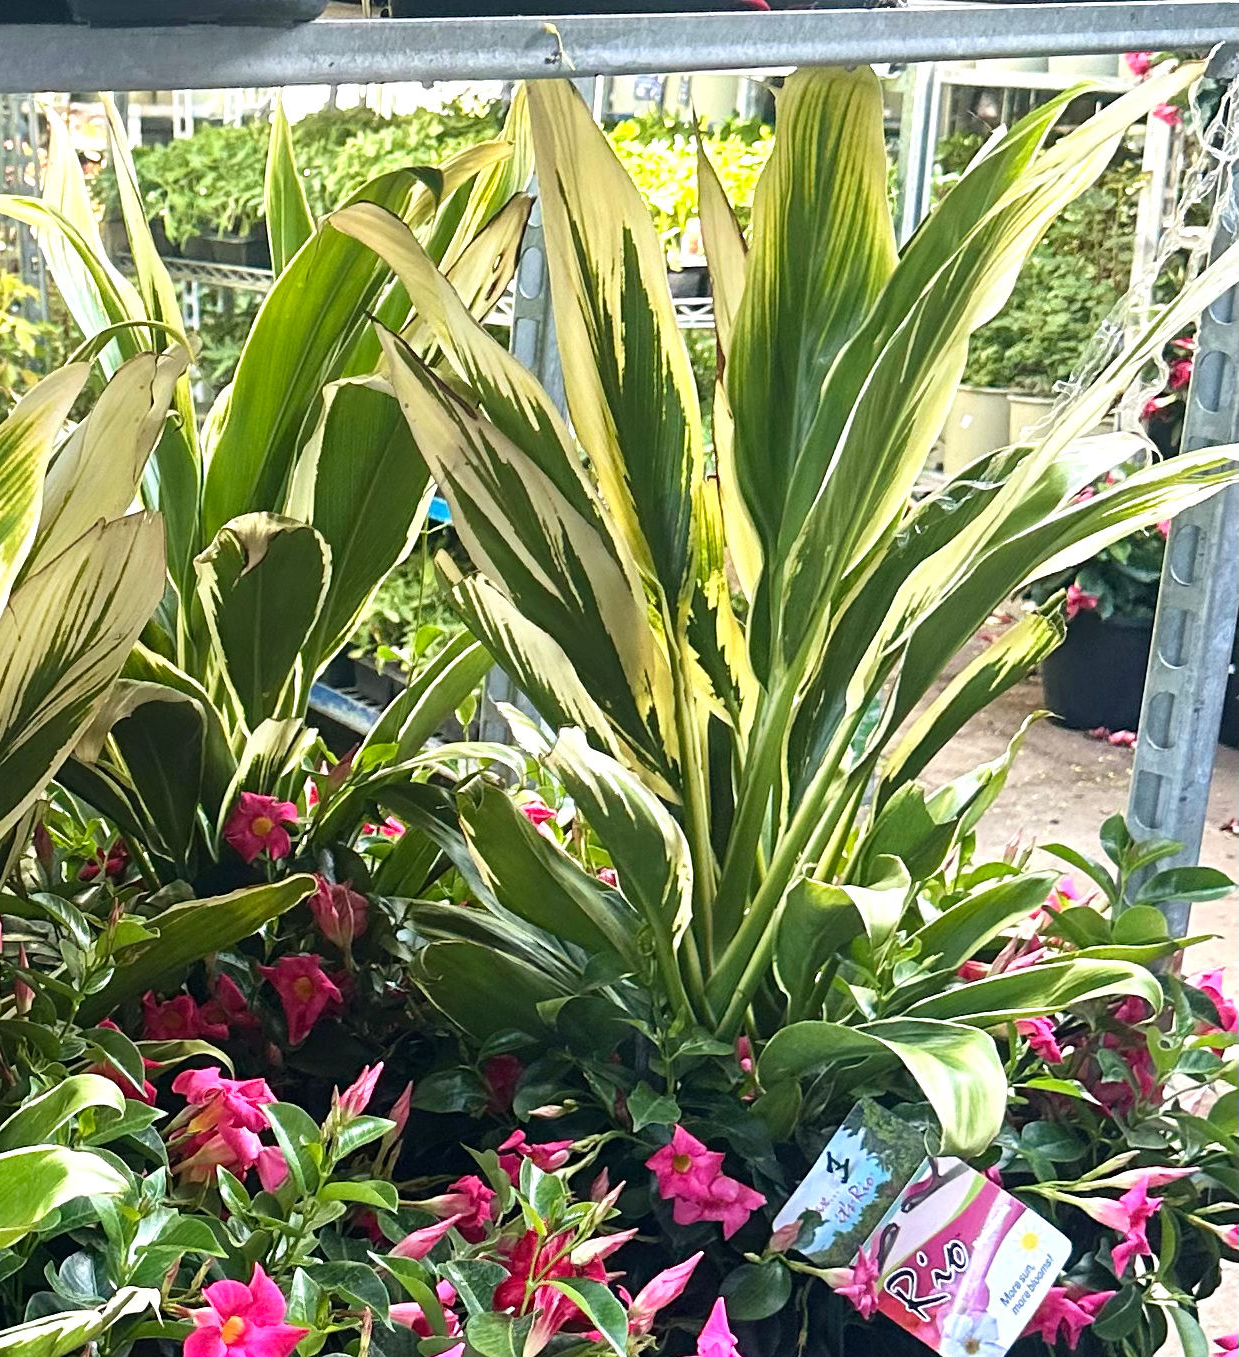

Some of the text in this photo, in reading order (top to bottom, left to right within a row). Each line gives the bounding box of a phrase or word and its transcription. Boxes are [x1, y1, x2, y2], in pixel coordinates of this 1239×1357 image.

[848, 1176, 874, 1200] Rio
[884, 1239, 969, 1322] Rio
[1000, 1280, 1022, 1307] More
[1012, 1253, 1055, 1315] more blooms!
